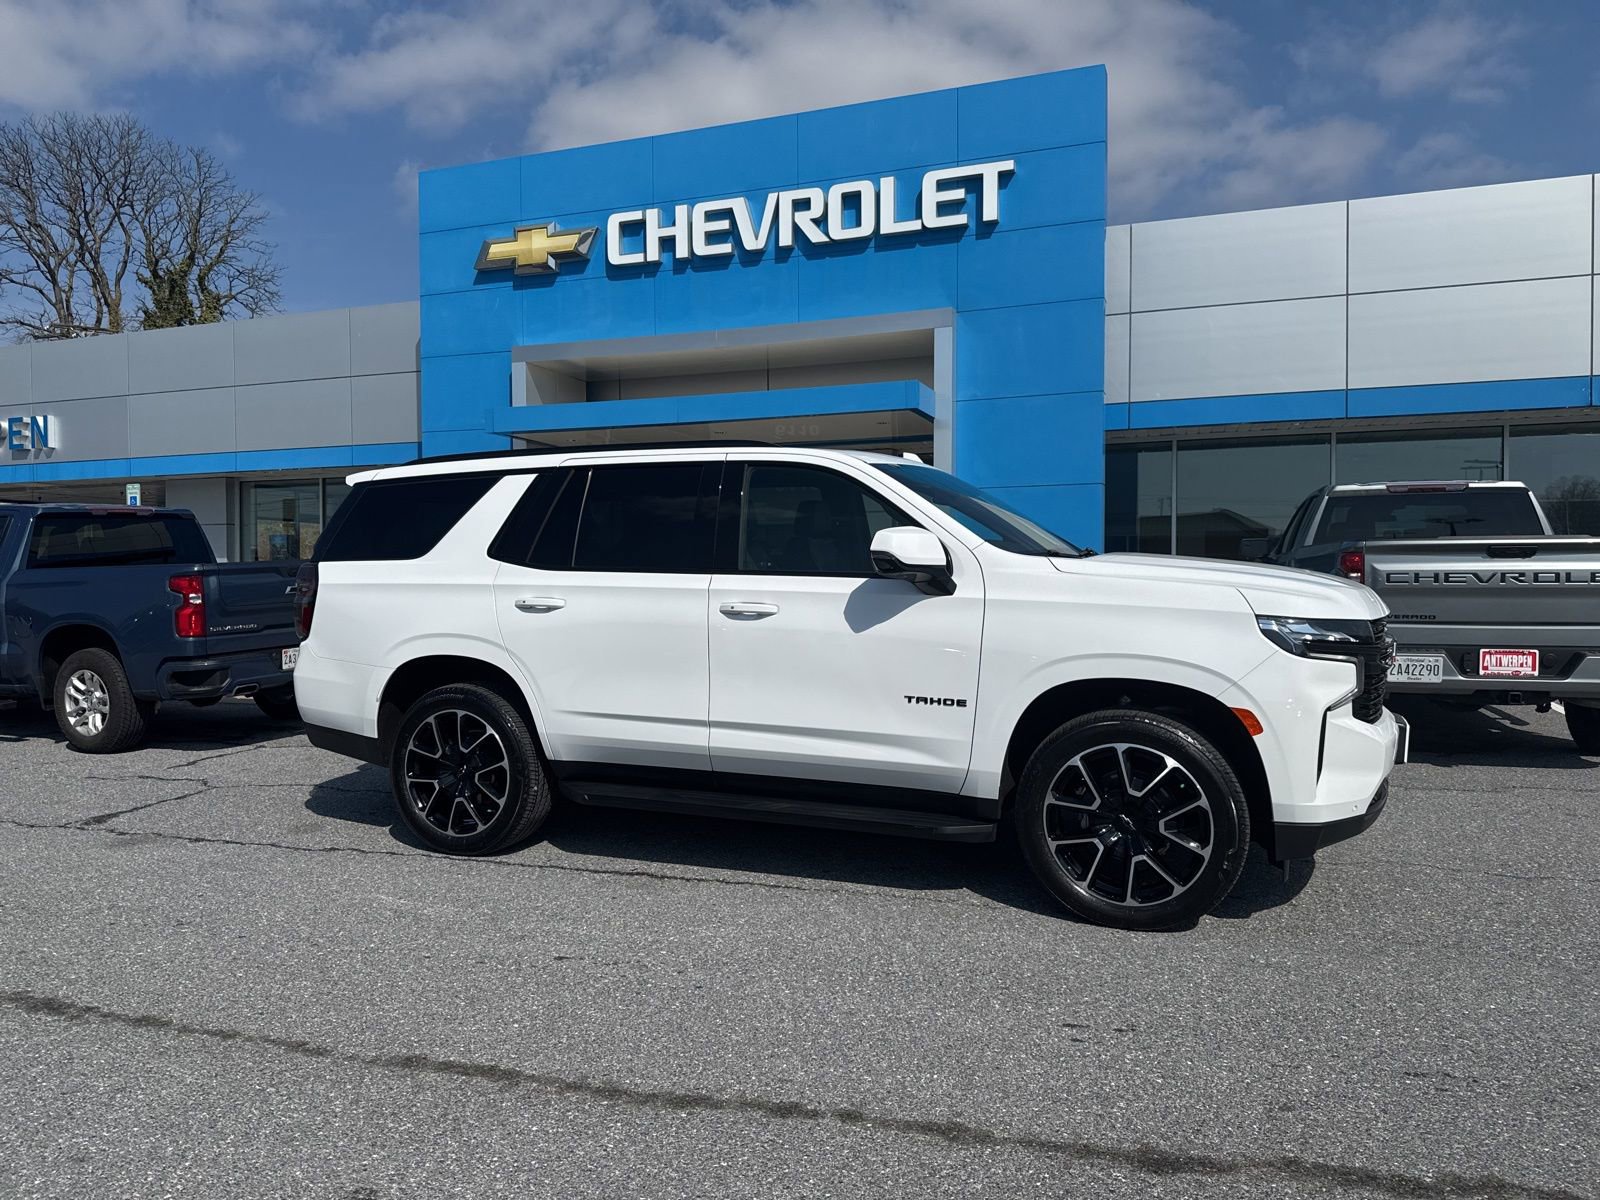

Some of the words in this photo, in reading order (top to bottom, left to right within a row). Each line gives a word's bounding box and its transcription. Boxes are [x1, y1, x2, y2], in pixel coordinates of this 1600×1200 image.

[607, 160, 1016, 266] CHEVROLET
[1, 415, 55, 450] EN
[284, 653, 298, 666] 2A3
[1483, 654, 1533, 669] ANTWERPEN
[1389, 663, 1440, 677] 2A42290
[904, 695, 968, 707] TAHOE
